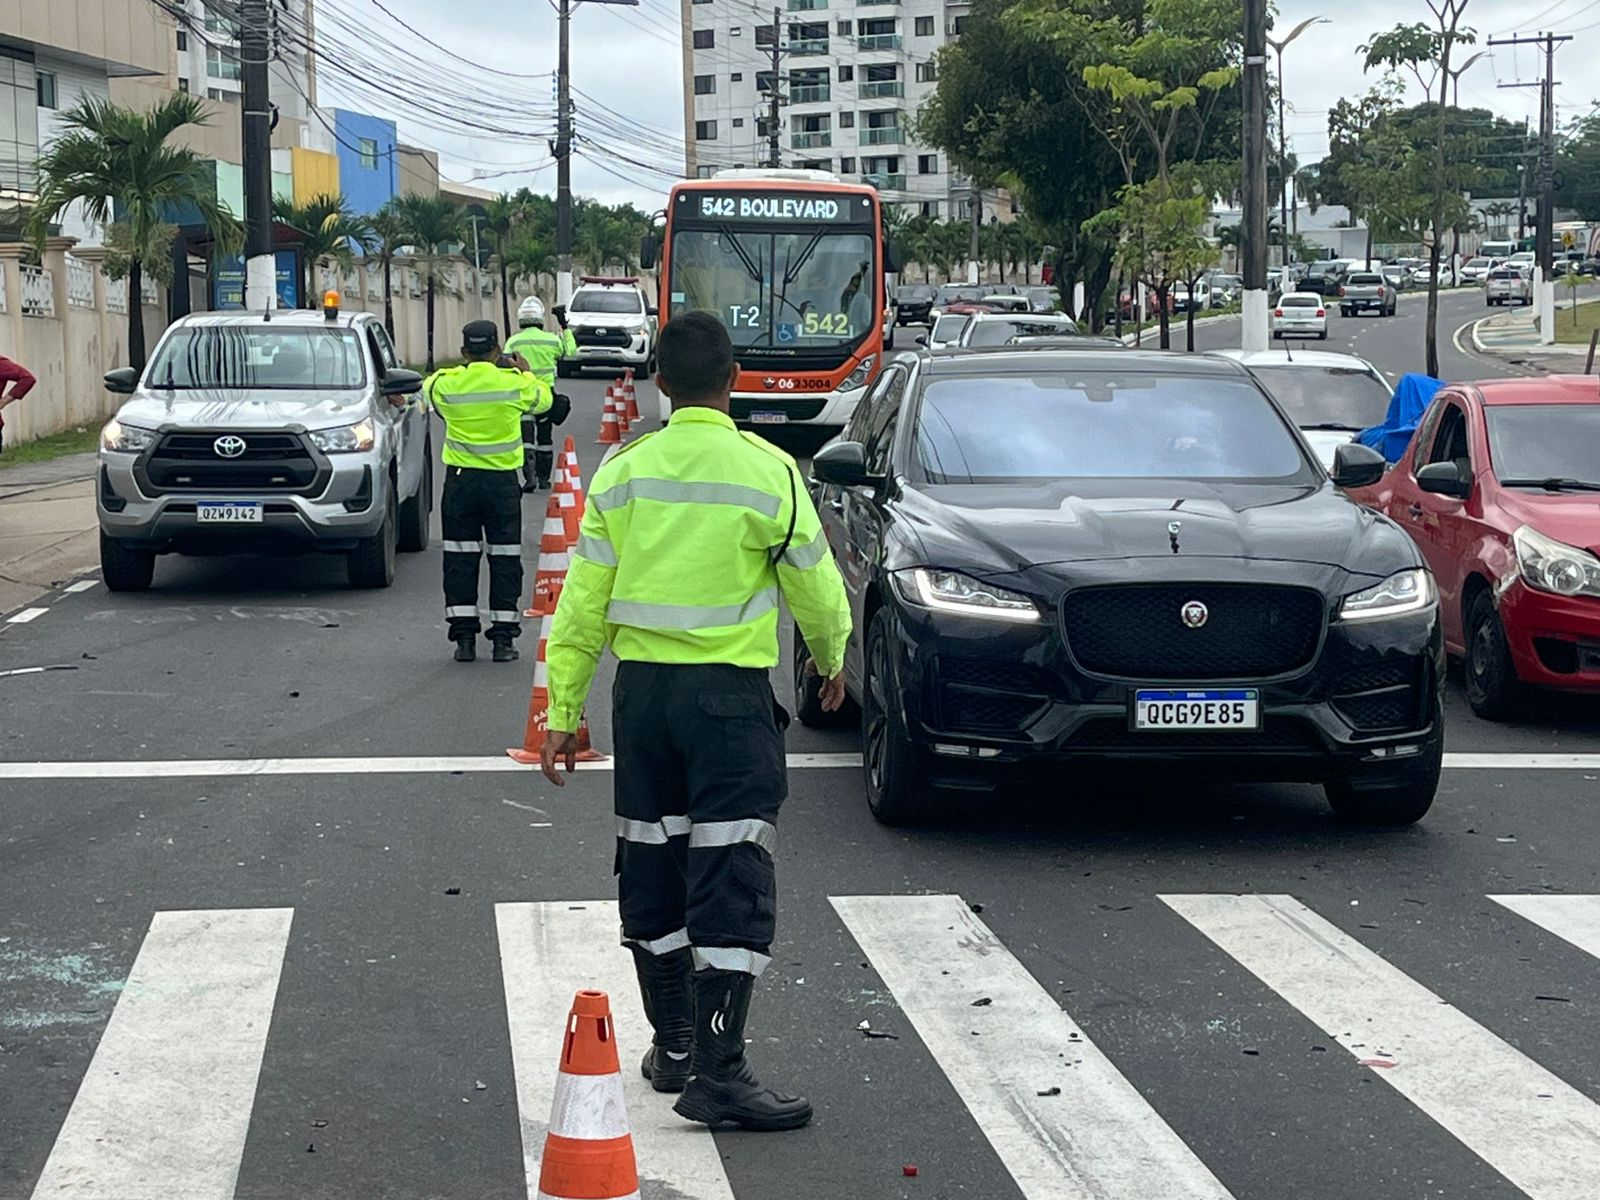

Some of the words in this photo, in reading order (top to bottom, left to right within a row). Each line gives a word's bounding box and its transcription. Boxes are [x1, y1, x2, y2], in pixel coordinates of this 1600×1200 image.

[702, 197, 735, 216] 542
[740, 198, 838, 218] BOULEVARD
[729, 305, 760, 327] T-2
[804, 312, 849, 334] 542
[1147, 702, 1245, 725] QCG9E85
